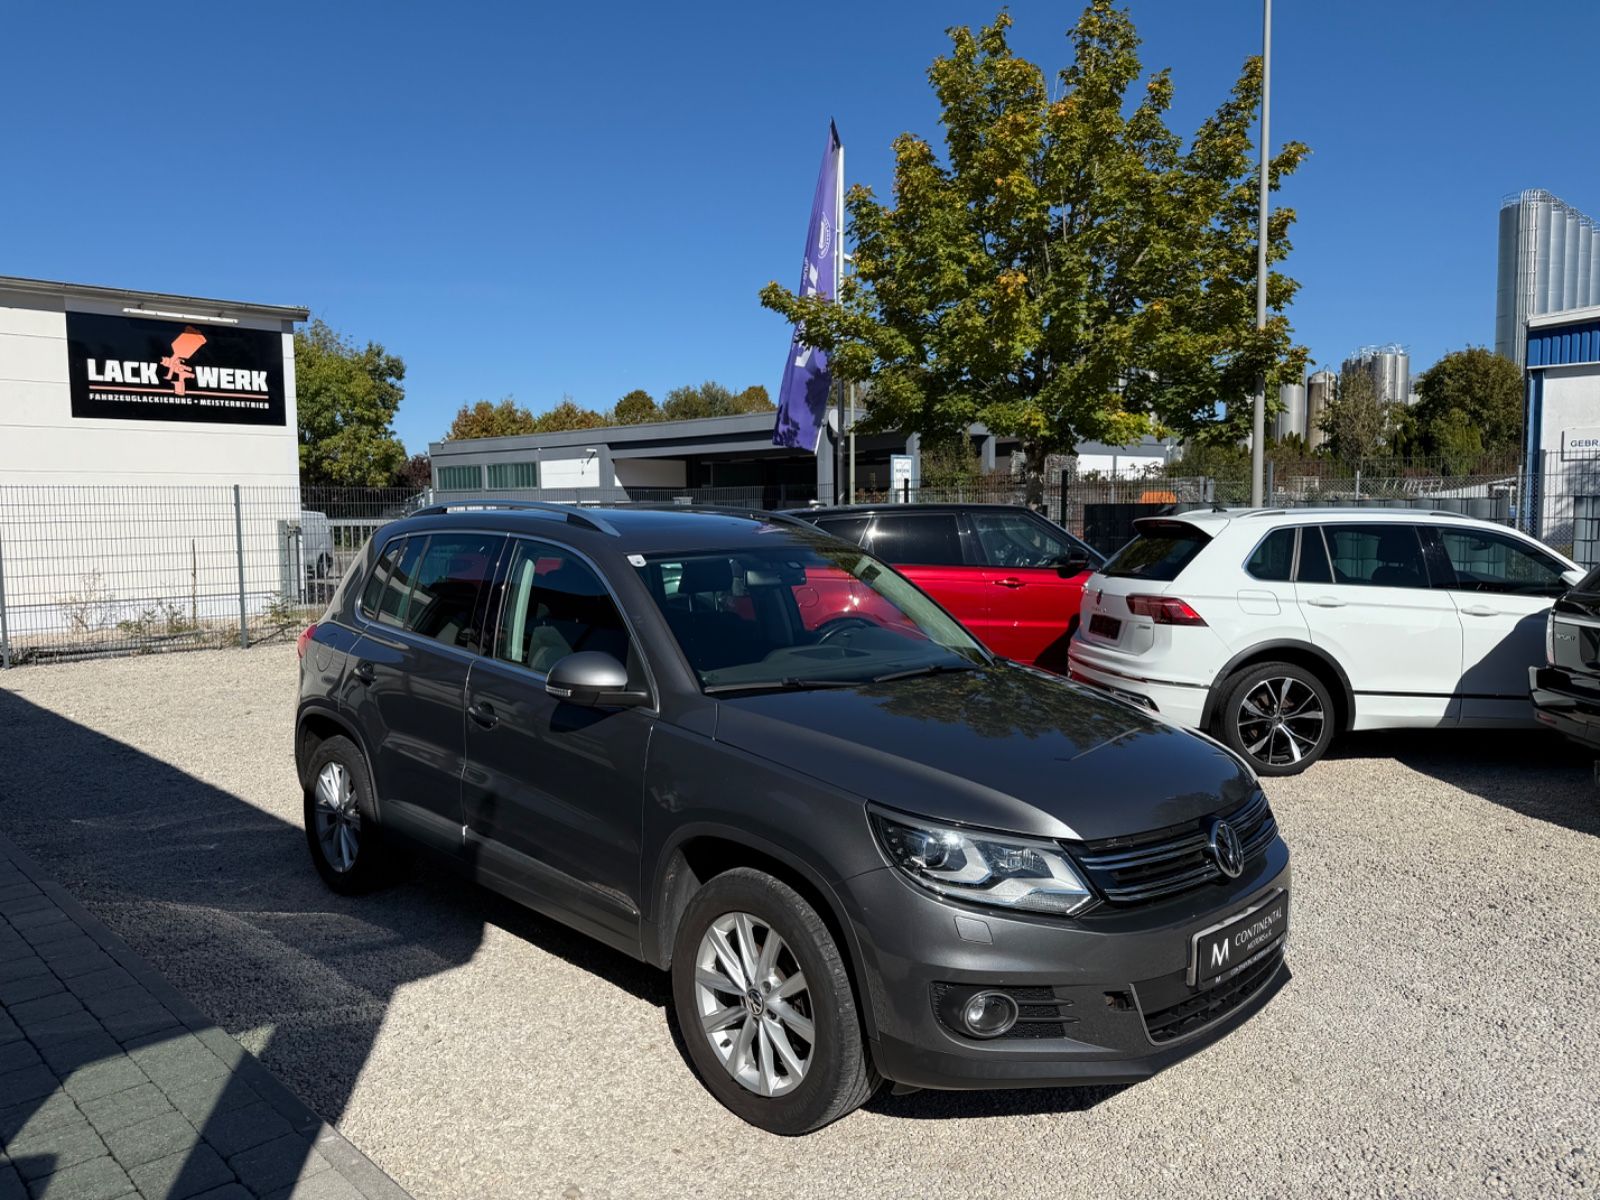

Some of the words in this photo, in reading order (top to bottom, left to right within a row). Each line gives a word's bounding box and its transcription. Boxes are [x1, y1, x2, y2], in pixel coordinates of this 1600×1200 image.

[87, 358, 159, 384] LACK
[195, 365, 269, 392] WERK
[89, 392, 193, 405] FAHRZEUGLACKIERUNG
[200, 399, 270, 410] MEISTERBETRIEB
[1570, 439, 1600, 448] GEBR
[1235, 906, 1282, 947] CONTINENTAL
